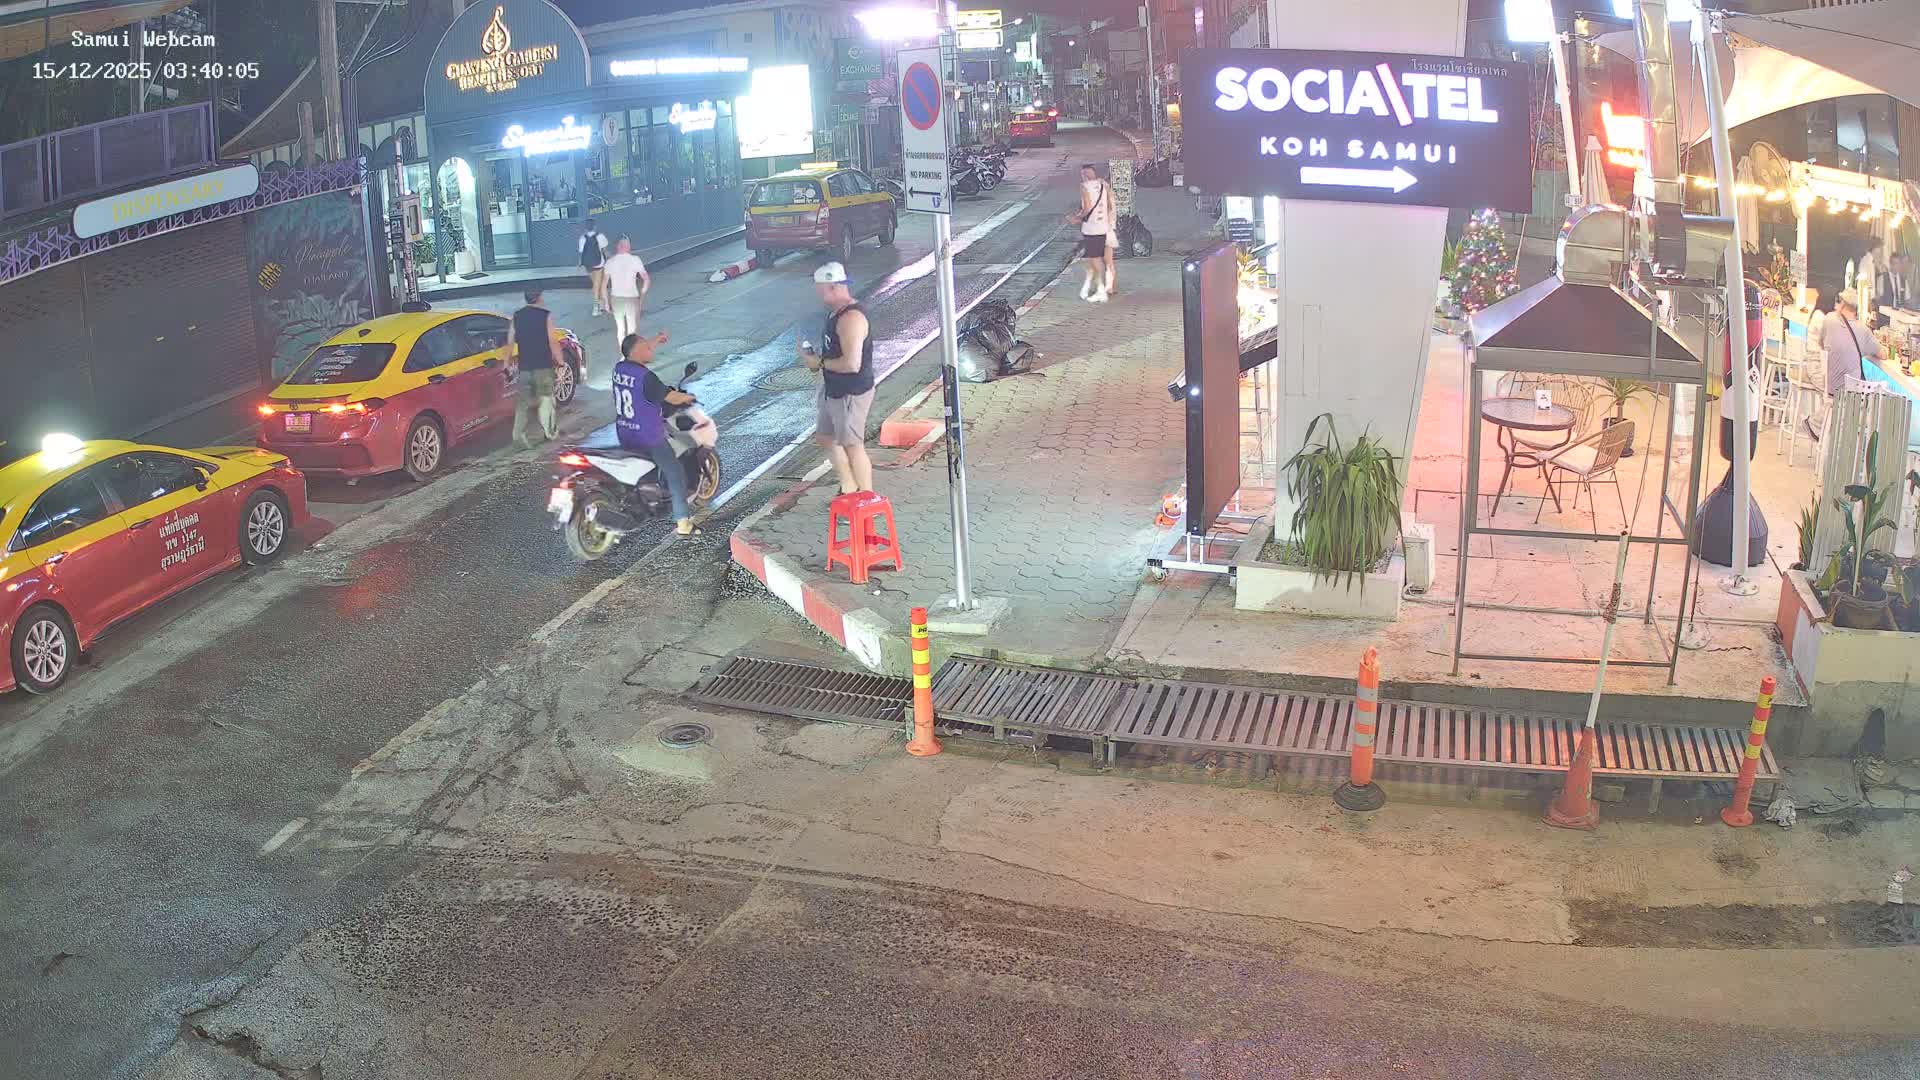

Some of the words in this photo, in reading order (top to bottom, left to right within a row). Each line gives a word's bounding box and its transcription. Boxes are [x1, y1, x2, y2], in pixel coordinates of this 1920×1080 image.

[840, 63, 880, 74] EXCHANGE
[1260, 136, 1328, 157] KOH
[1347, 139, 1457, 164] SAMUI
[911, 171, 918, 179] NO
[919, 171, 942, 180] PARKING
[113, 179, 224, 222] DISPENSARY
